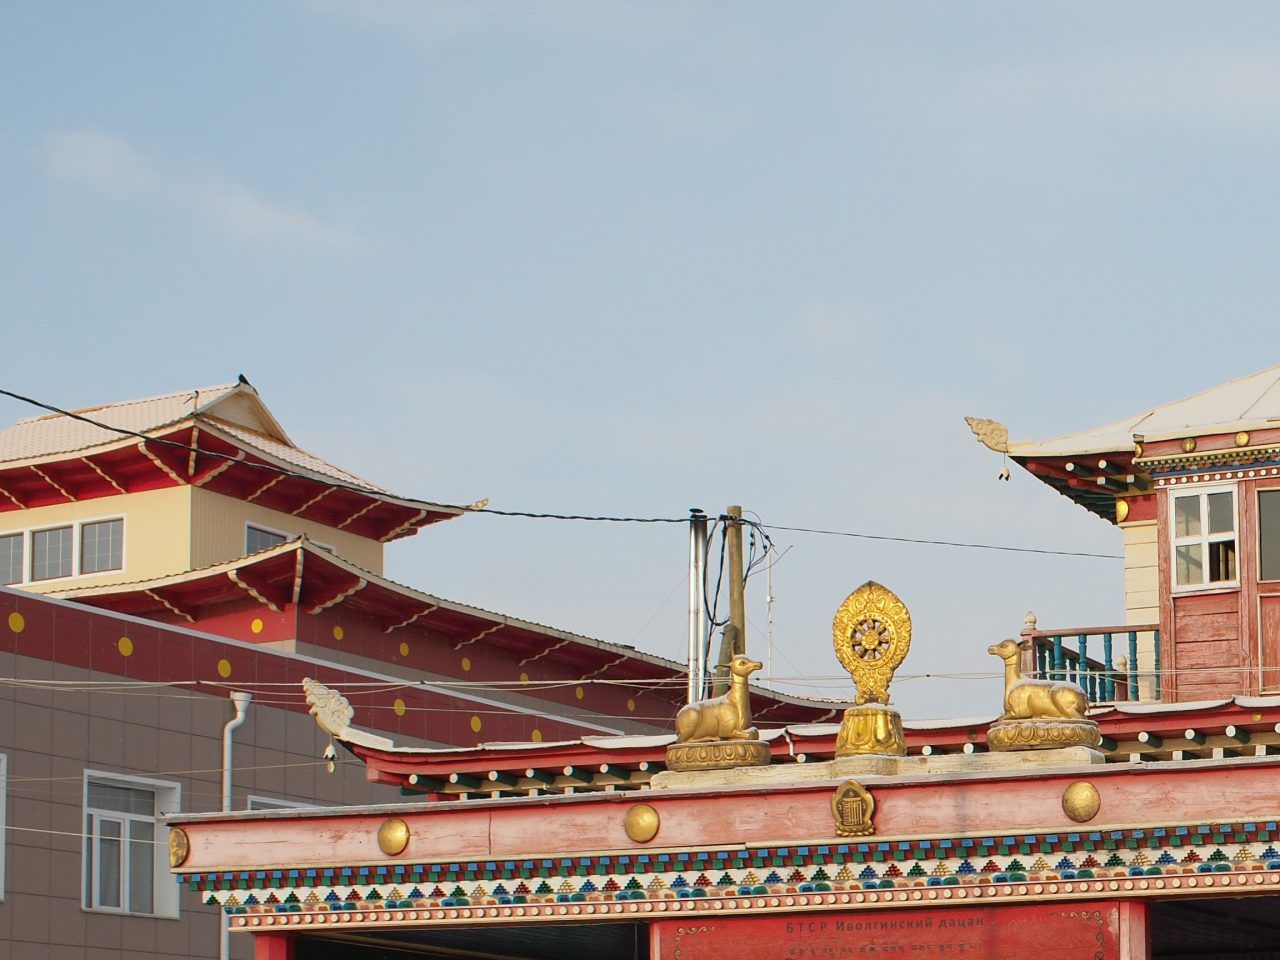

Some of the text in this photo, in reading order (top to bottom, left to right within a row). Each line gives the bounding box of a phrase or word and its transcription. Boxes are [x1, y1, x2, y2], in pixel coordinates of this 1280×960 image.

[786, 916, 985, 934] БТСР Иволгинский дацан
